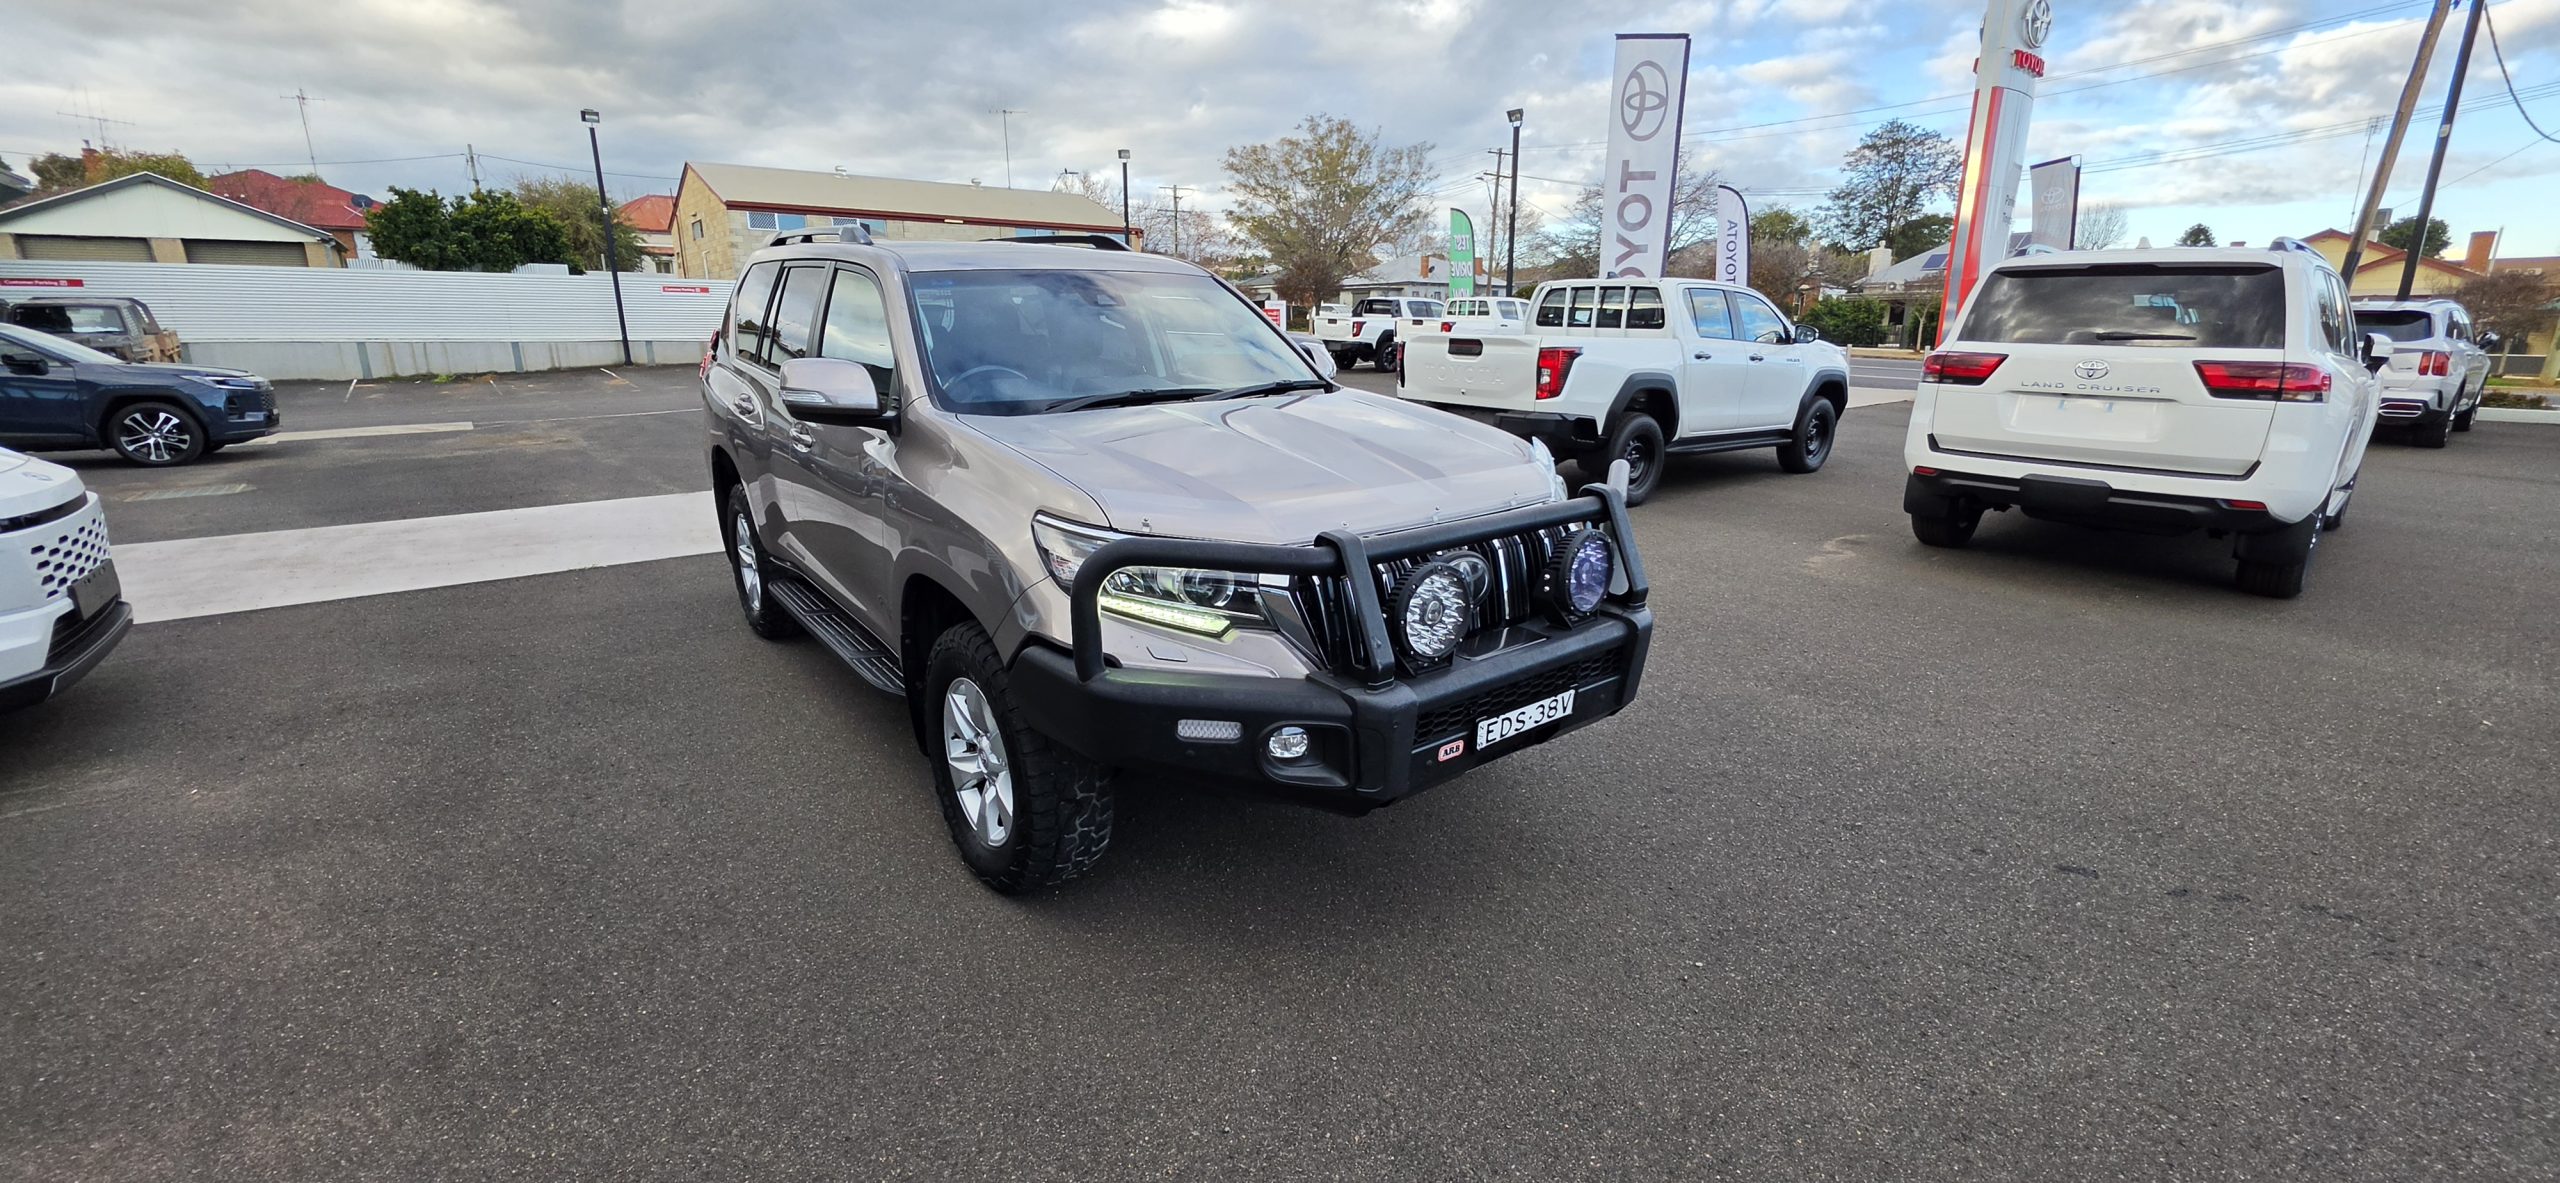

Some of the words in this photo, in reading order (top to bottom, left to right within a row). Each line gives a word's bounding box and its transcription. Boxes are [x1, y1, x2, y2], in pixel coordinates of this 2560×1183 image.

[2021, 381, 2065, 389] LAND
[2076, 383, 2161, 393] CRUISER
[1442, 744, 1461, 758] ARB
